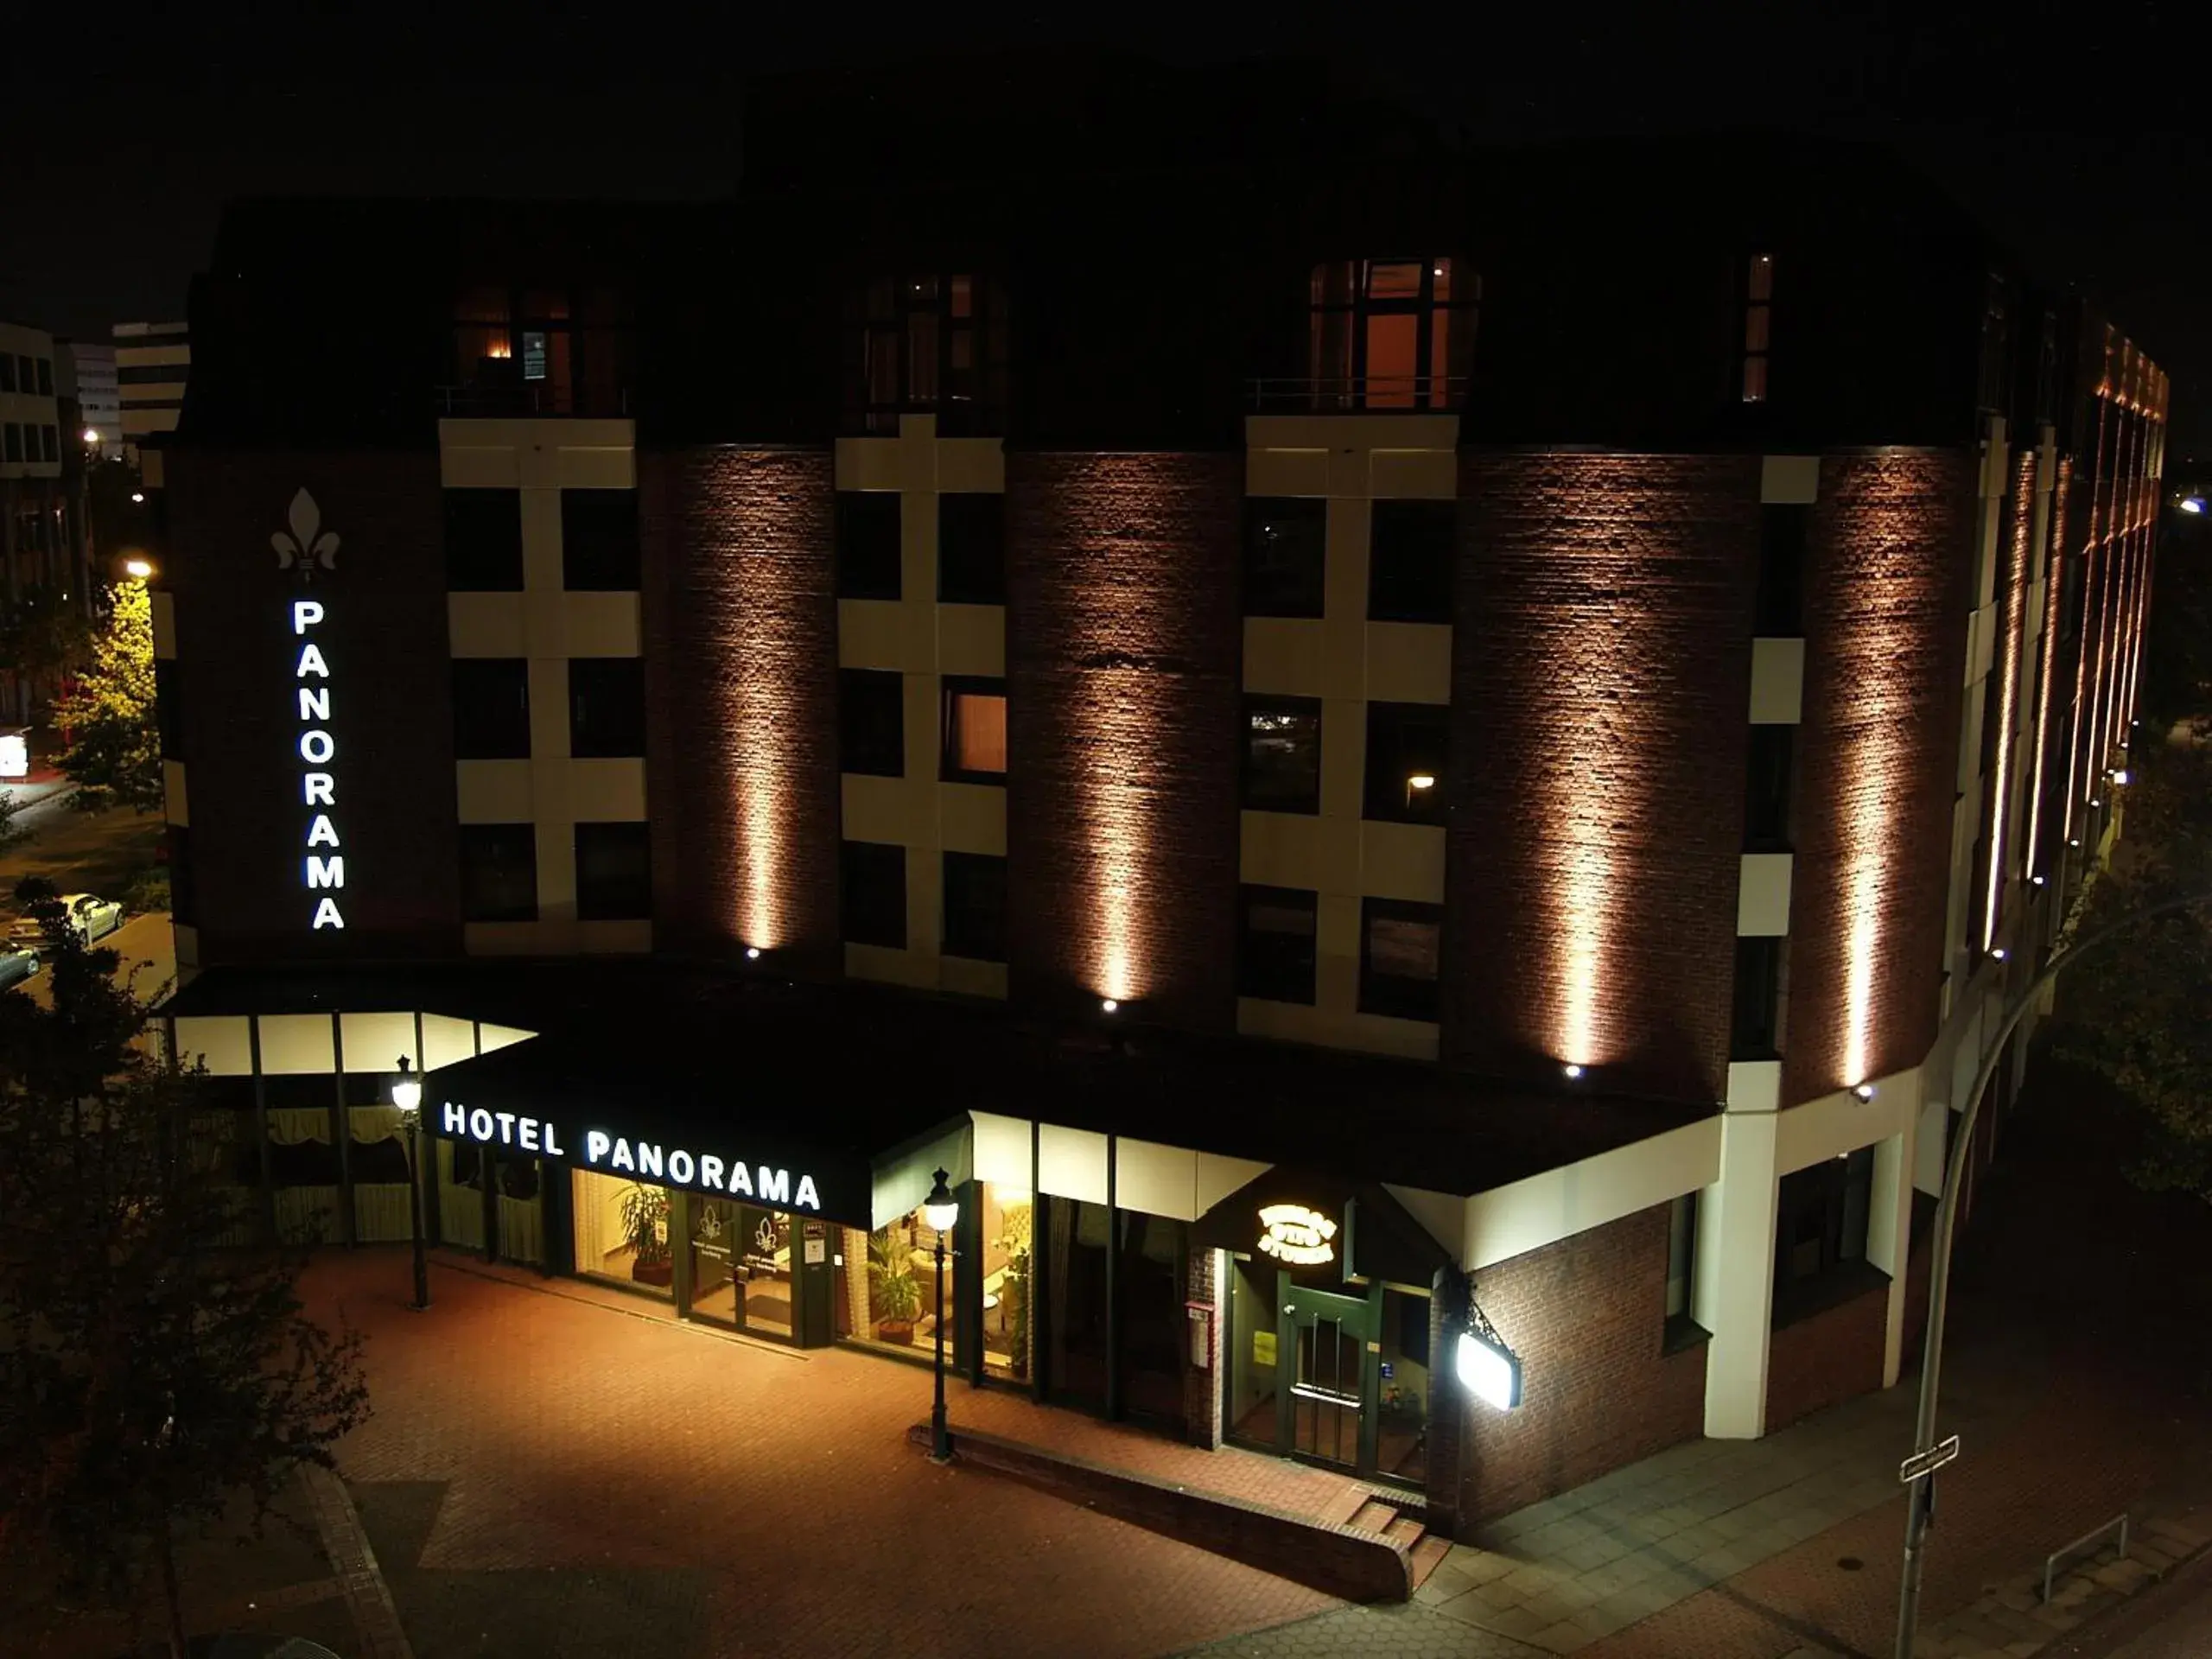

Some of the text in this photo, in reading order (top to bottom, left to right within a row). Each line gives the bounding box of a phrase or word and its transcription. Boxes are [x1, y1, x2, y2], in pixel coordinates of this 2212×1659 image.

[293, 601, 345, 930] PANORAMA
[442, 1102, 821, 1211] HOTEL PANORAMA
